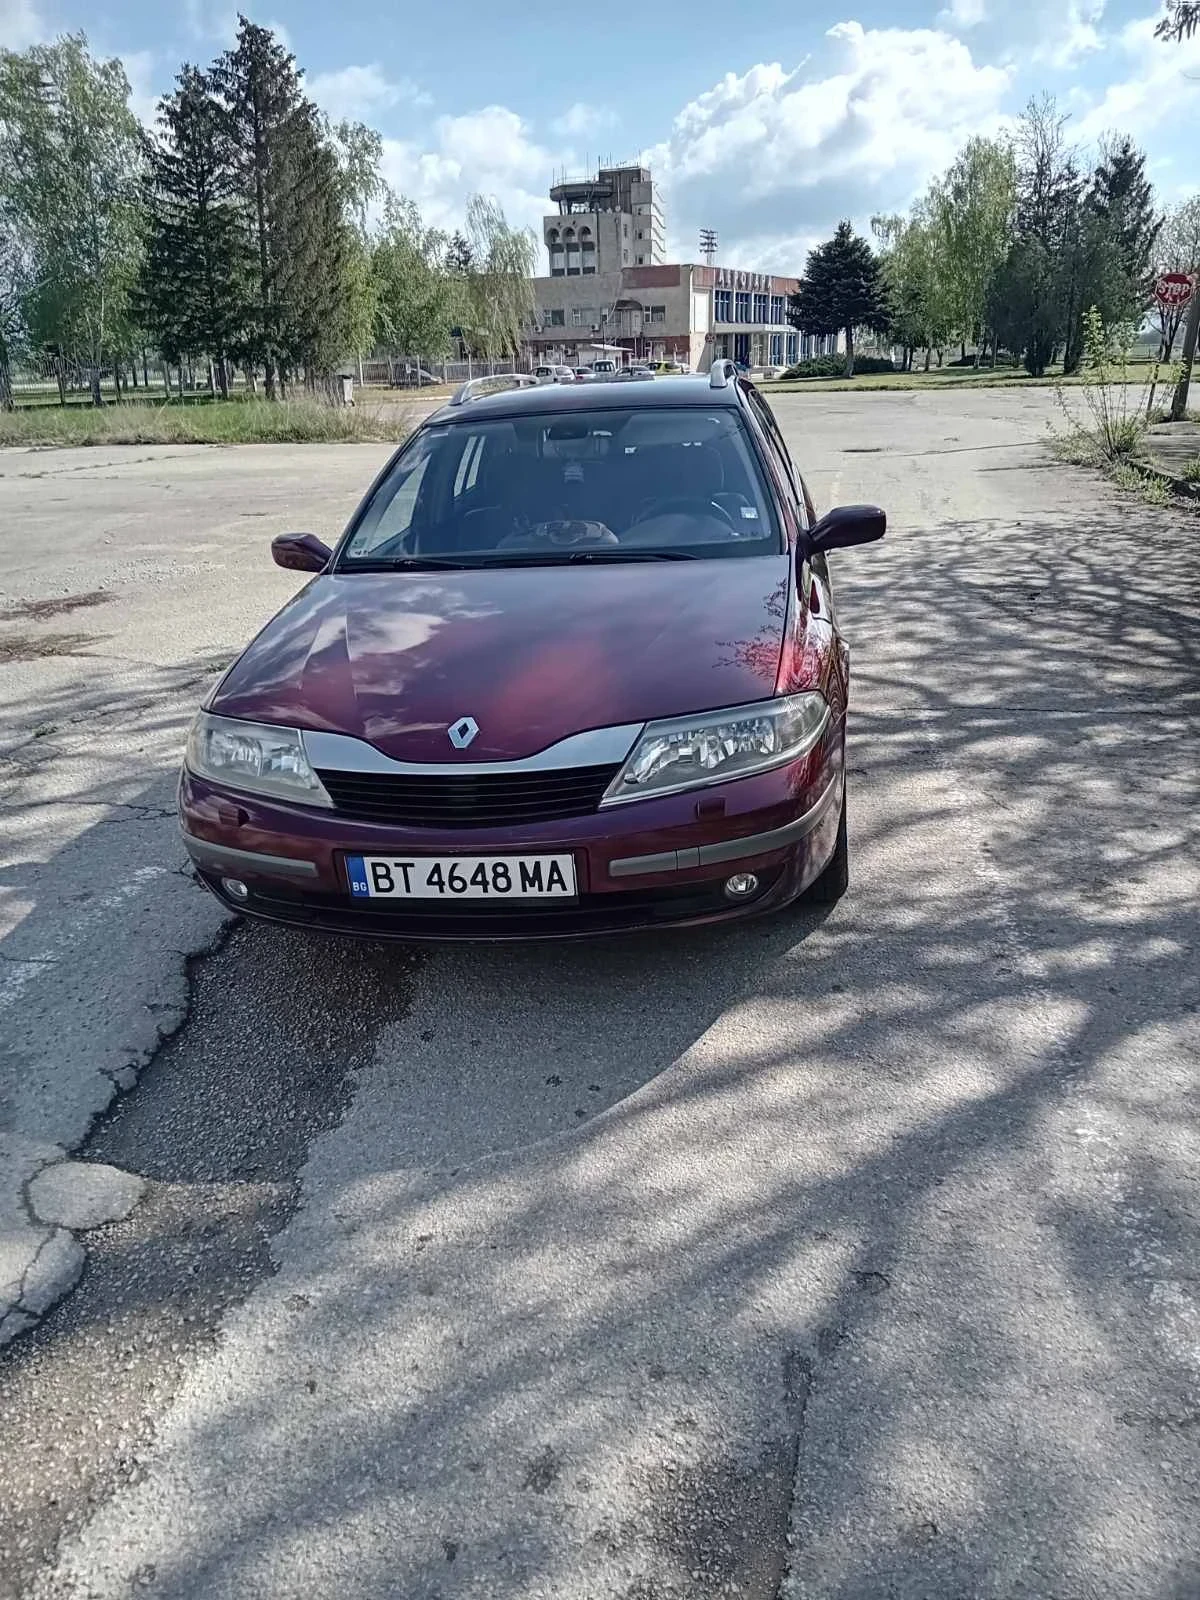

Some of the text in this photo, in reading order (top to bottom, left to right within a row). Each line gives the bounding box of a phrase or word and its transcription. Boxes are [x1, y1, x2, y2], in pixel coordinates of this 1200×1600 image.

[1157, 280, 1190, 298] STOP
[371, 860, 568, 894] BT 4648 MA
[352, 881, 367, 892] BG
